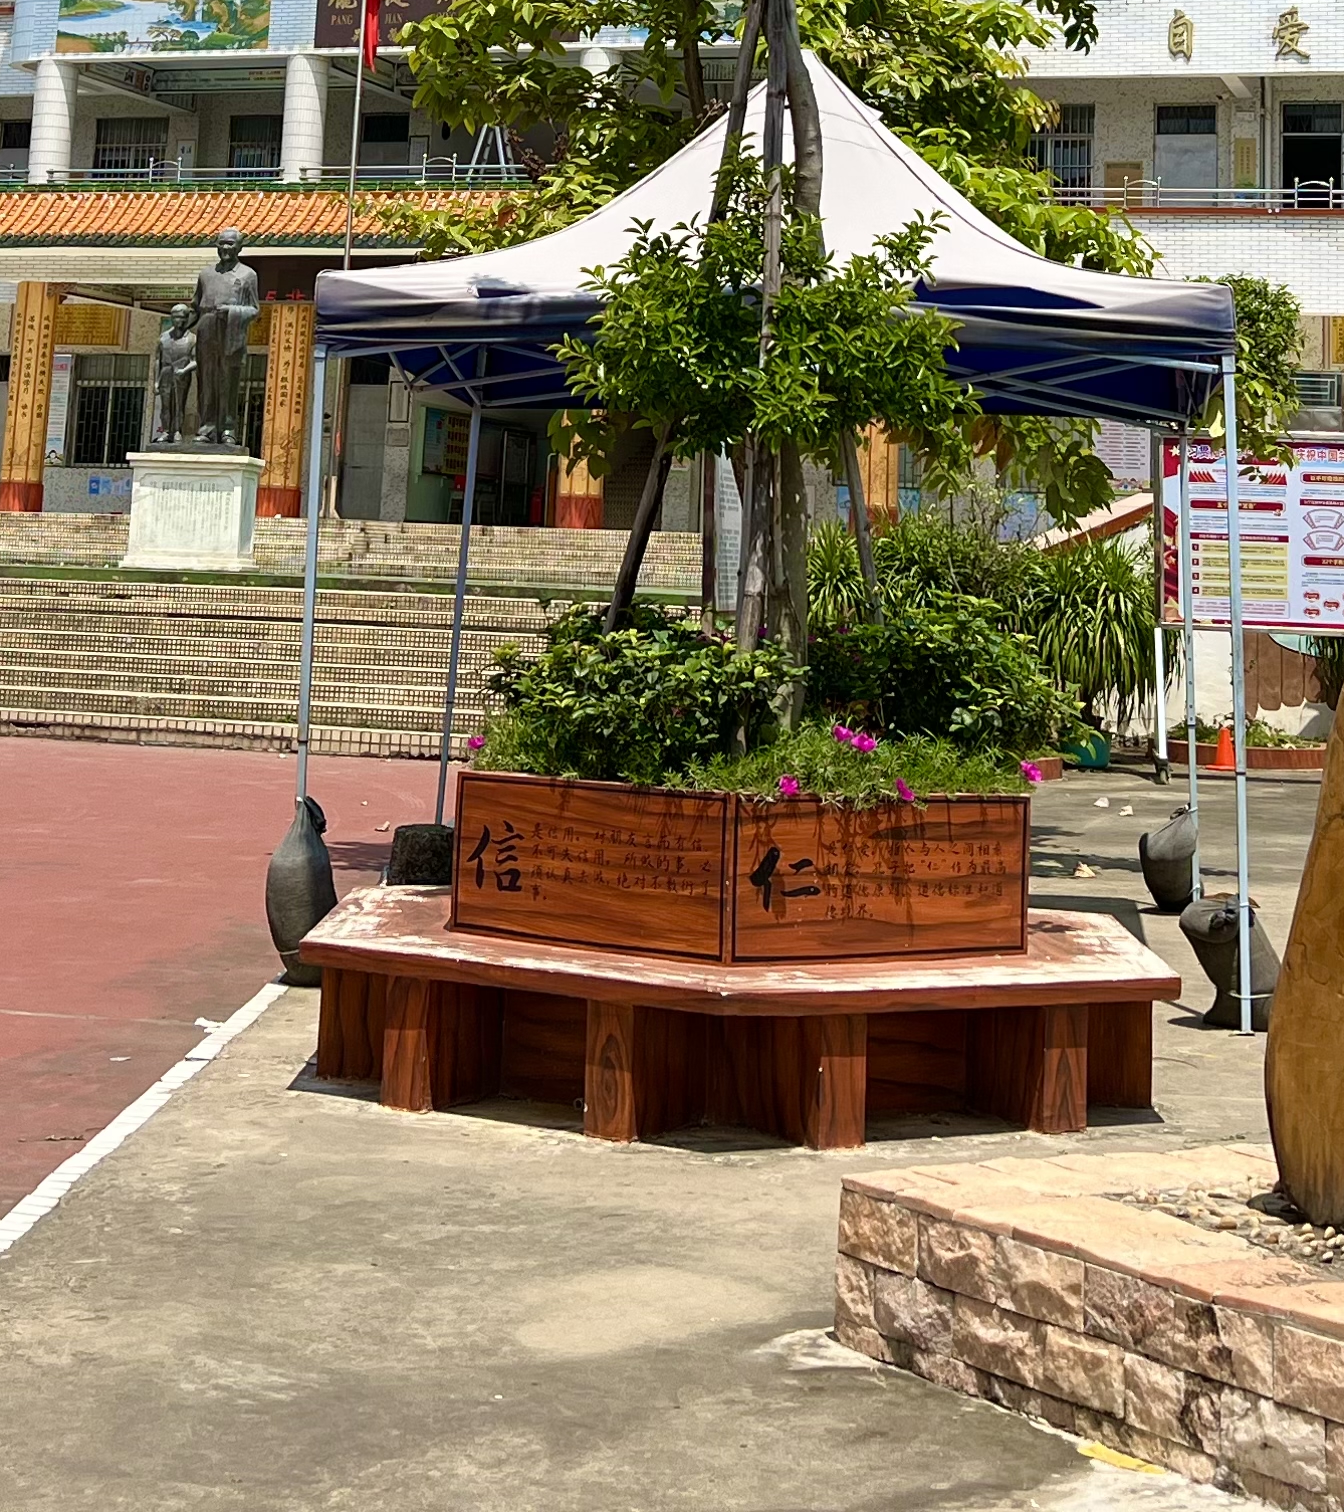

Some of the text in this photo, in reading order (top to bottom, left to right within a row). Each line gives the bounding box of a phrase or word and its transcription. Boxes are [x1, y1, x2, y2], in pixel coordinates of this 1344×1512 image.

[330, 14, 354, 27] PANG
[384, 12, 404, 25] JIAN
[1167, 6, 1312, 62] 自爱
[466, 820, 525, 892] 信
[750, 846, 821, 912] 仁
